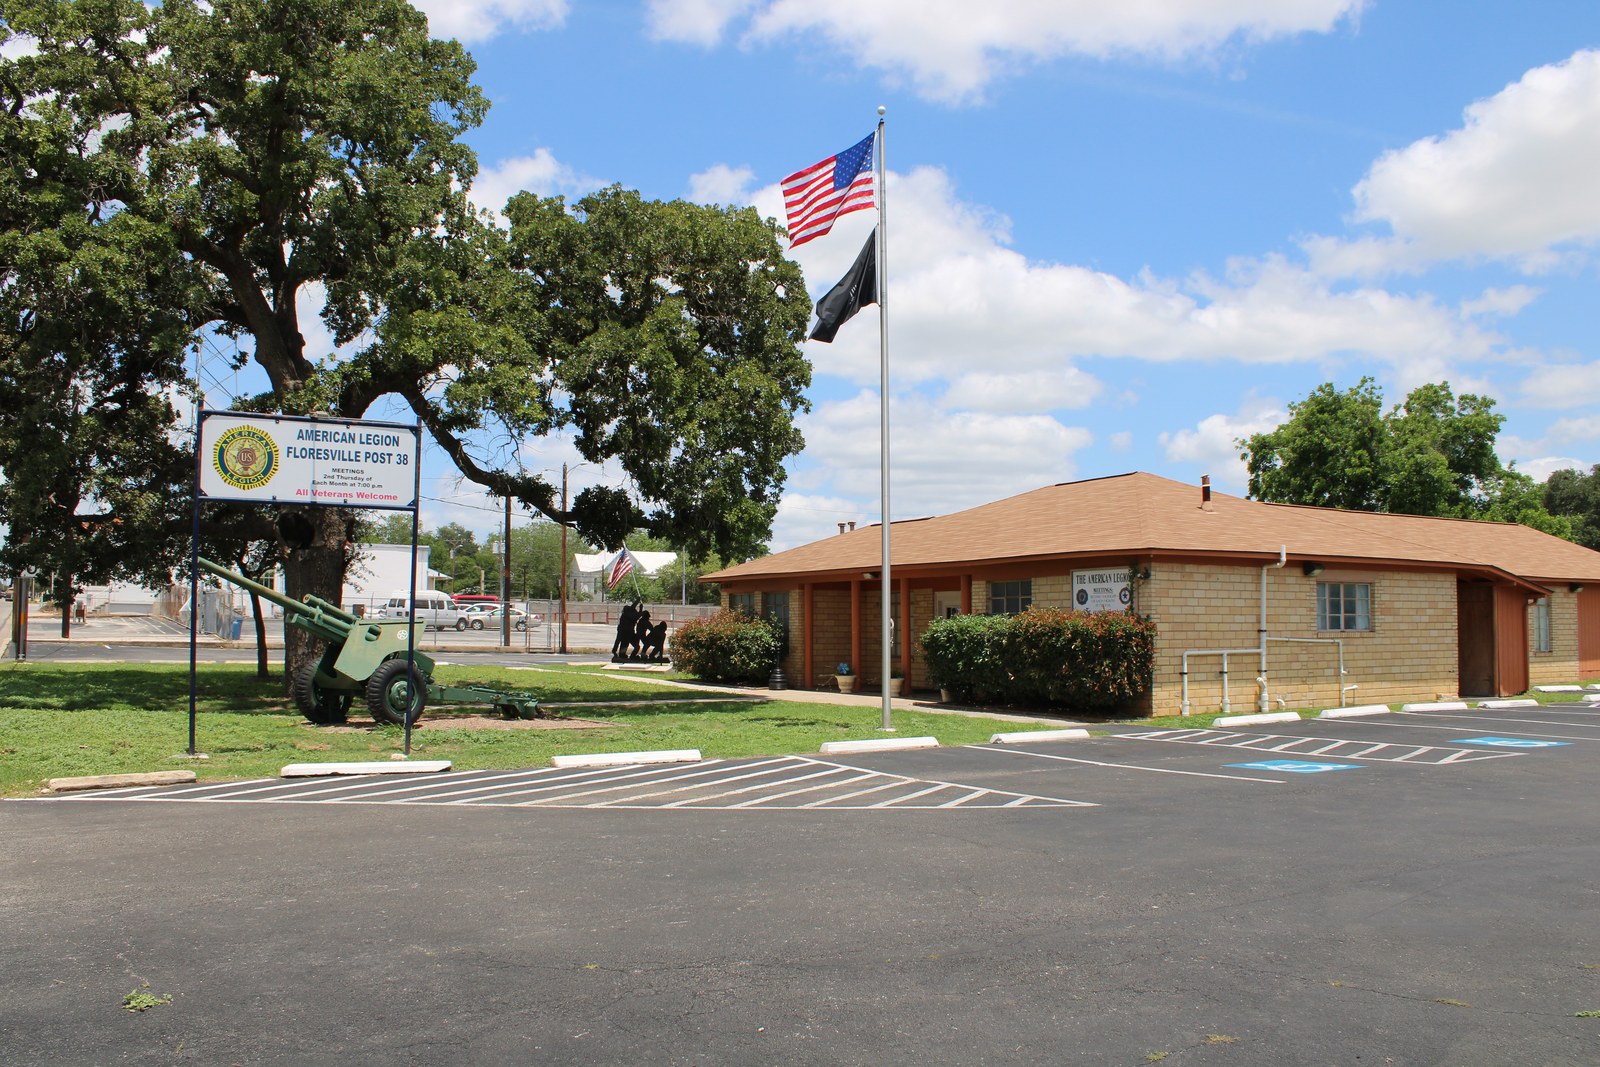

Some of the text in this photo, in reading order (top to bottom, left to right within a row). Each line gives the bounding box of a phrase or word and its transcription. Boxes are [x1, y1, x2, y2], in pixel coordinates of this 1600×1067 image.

[222, 431, 272, 452] AMERICAN
[297, 429, 400, 447] AMERICAN LEGION
[286, 447, 409, 466] FLORESVILLE POST 38
[227, 472, 264, 484] LEGION
[336, 474, 364, 482] Thursday
[295, 488, 398, 501] All Veterans Welcome
[1076, 574, 1086, 585] THE
[1088, 572, 1112, 584] AMERICAN
